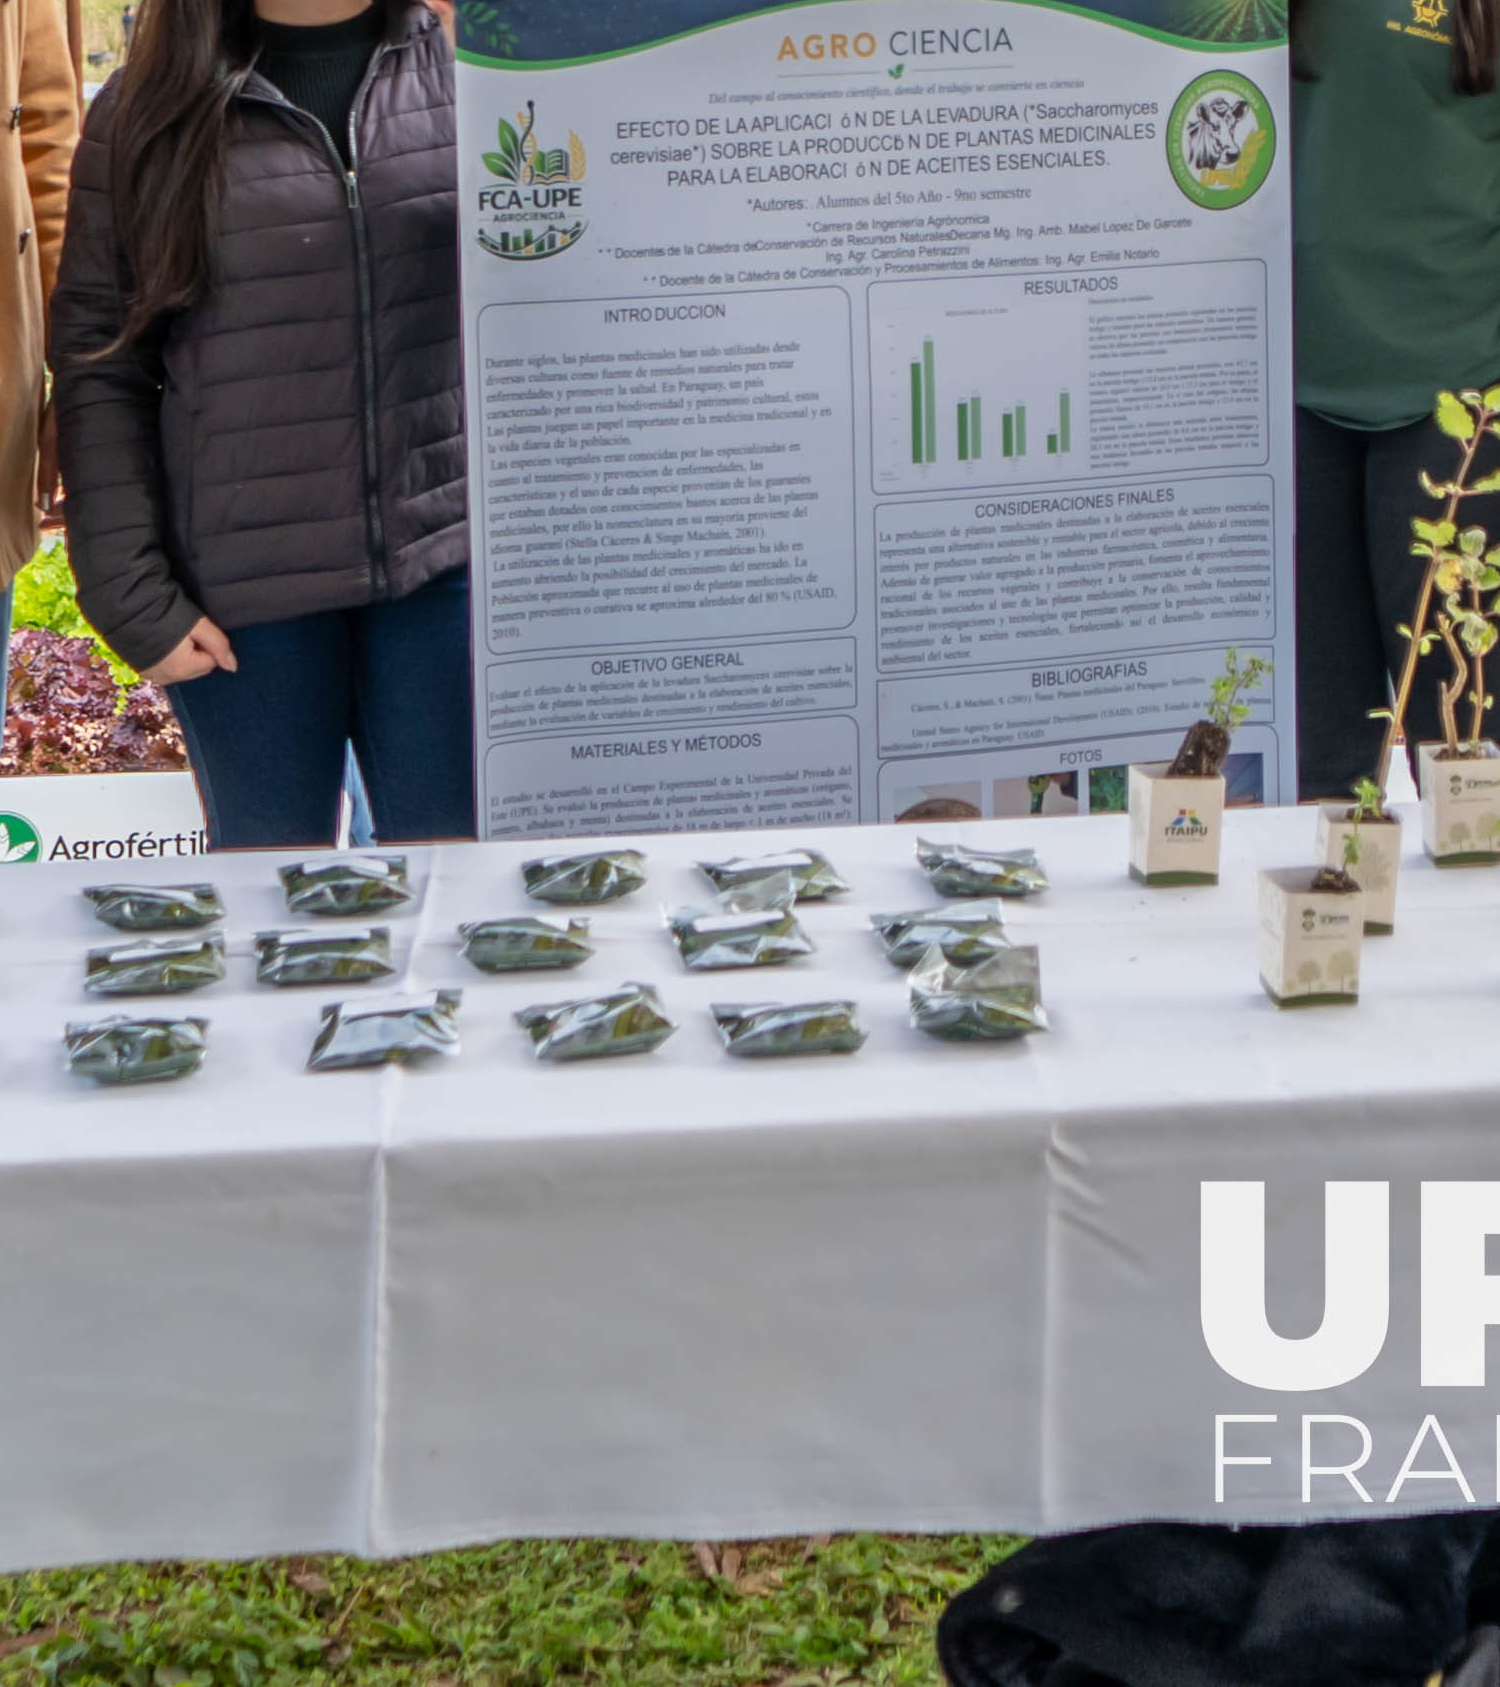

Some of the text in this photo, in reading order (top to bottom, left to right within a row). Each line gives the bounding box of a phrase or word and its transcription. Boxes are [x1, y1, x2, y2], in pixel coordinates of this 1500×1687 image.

[778, 27, 1013, 60] AGRO CIENCIA
[616, 119, 690, 139] EFECTO
[695, 118, 720, 136] DE
[726, 117, 748, 134] LA
[872, 110, 896, 127] DE
[901, 109, 923, 125] LA
[926, 105, 1020, 124] LEVADURA
[711, 141, 773, 160] SOBRE
[778, 139, 800, 156] LA
[926, 132, 950, 149] DE
[956, 128, 1034, 147] PLANTAS
[1039, 123, 1156, 143] MEDICINALES
[668, 169, 716, 187] PARA
[720, 167, 742, 184] LA
[887, 159, 911, 176] DE
[916, 155, 990, 174] ACEITES
[996, 149, 1110, 171] ESENCIALES.
[478, 188, 582, 210] FCA-UPE
[816, 195, 870, 209] Alumnos
[872, 191, 892, 206] del
[895, 191, 914, 205] 5to
[917, 190, 943, 203] Año
[954, 189, 976, 201] 9no
[980, 188, 1031, 200] semestre
[493, 212, 565, 223] AGROCIENCIA
[1024, 277, 1118, 295] RESULTADOS
[975, 488, 1174, 519] CONSIDERACIONES FINALES
[591, 652, 744, 675] OBJETIVO GENERAL
[571, 733, 762, 759] MATERIALES Y MÉTODOS
[1059, 749, 1102, 766] FOTOS
[1165, 826, 1208, 836] ITAIPU
